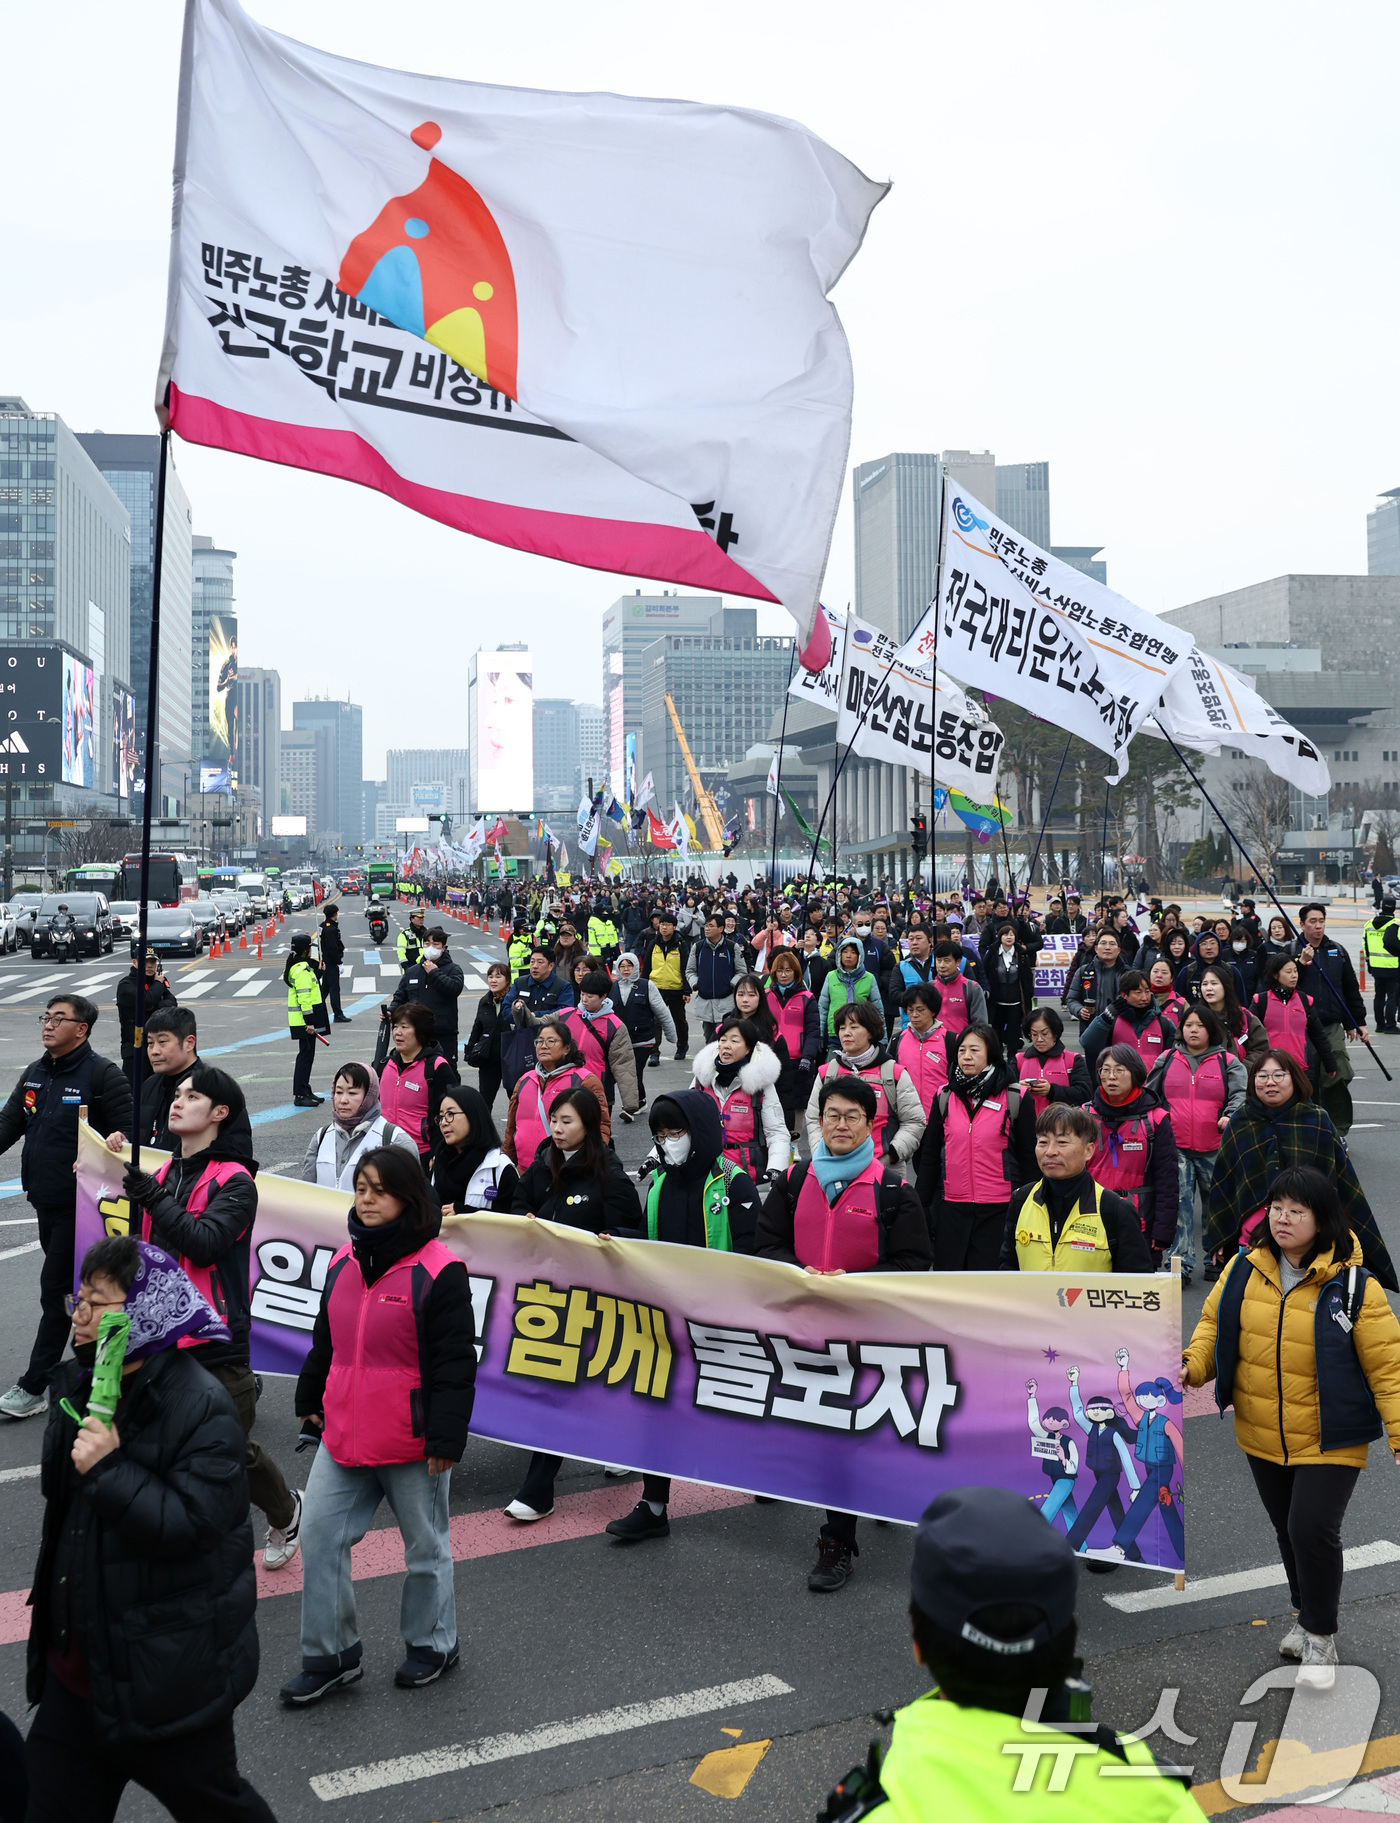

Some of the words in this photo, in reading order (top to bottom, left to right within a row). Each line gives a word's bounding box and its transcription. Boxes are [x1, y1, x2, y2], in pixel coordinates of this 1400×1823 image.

[201, 241, 311, 310] 민주노총
[989, 526, 1048, 576] 민주노총
[845, 665, 1004, 774] 마트산업노동조합
[1035, 969, 1070, 986] 쟁취
[1086, 1289, 1161, 1312] 민주노총
[507, 1281, 673, 1400] 함께
[687, 1319, 960, 1450] 돌보자
